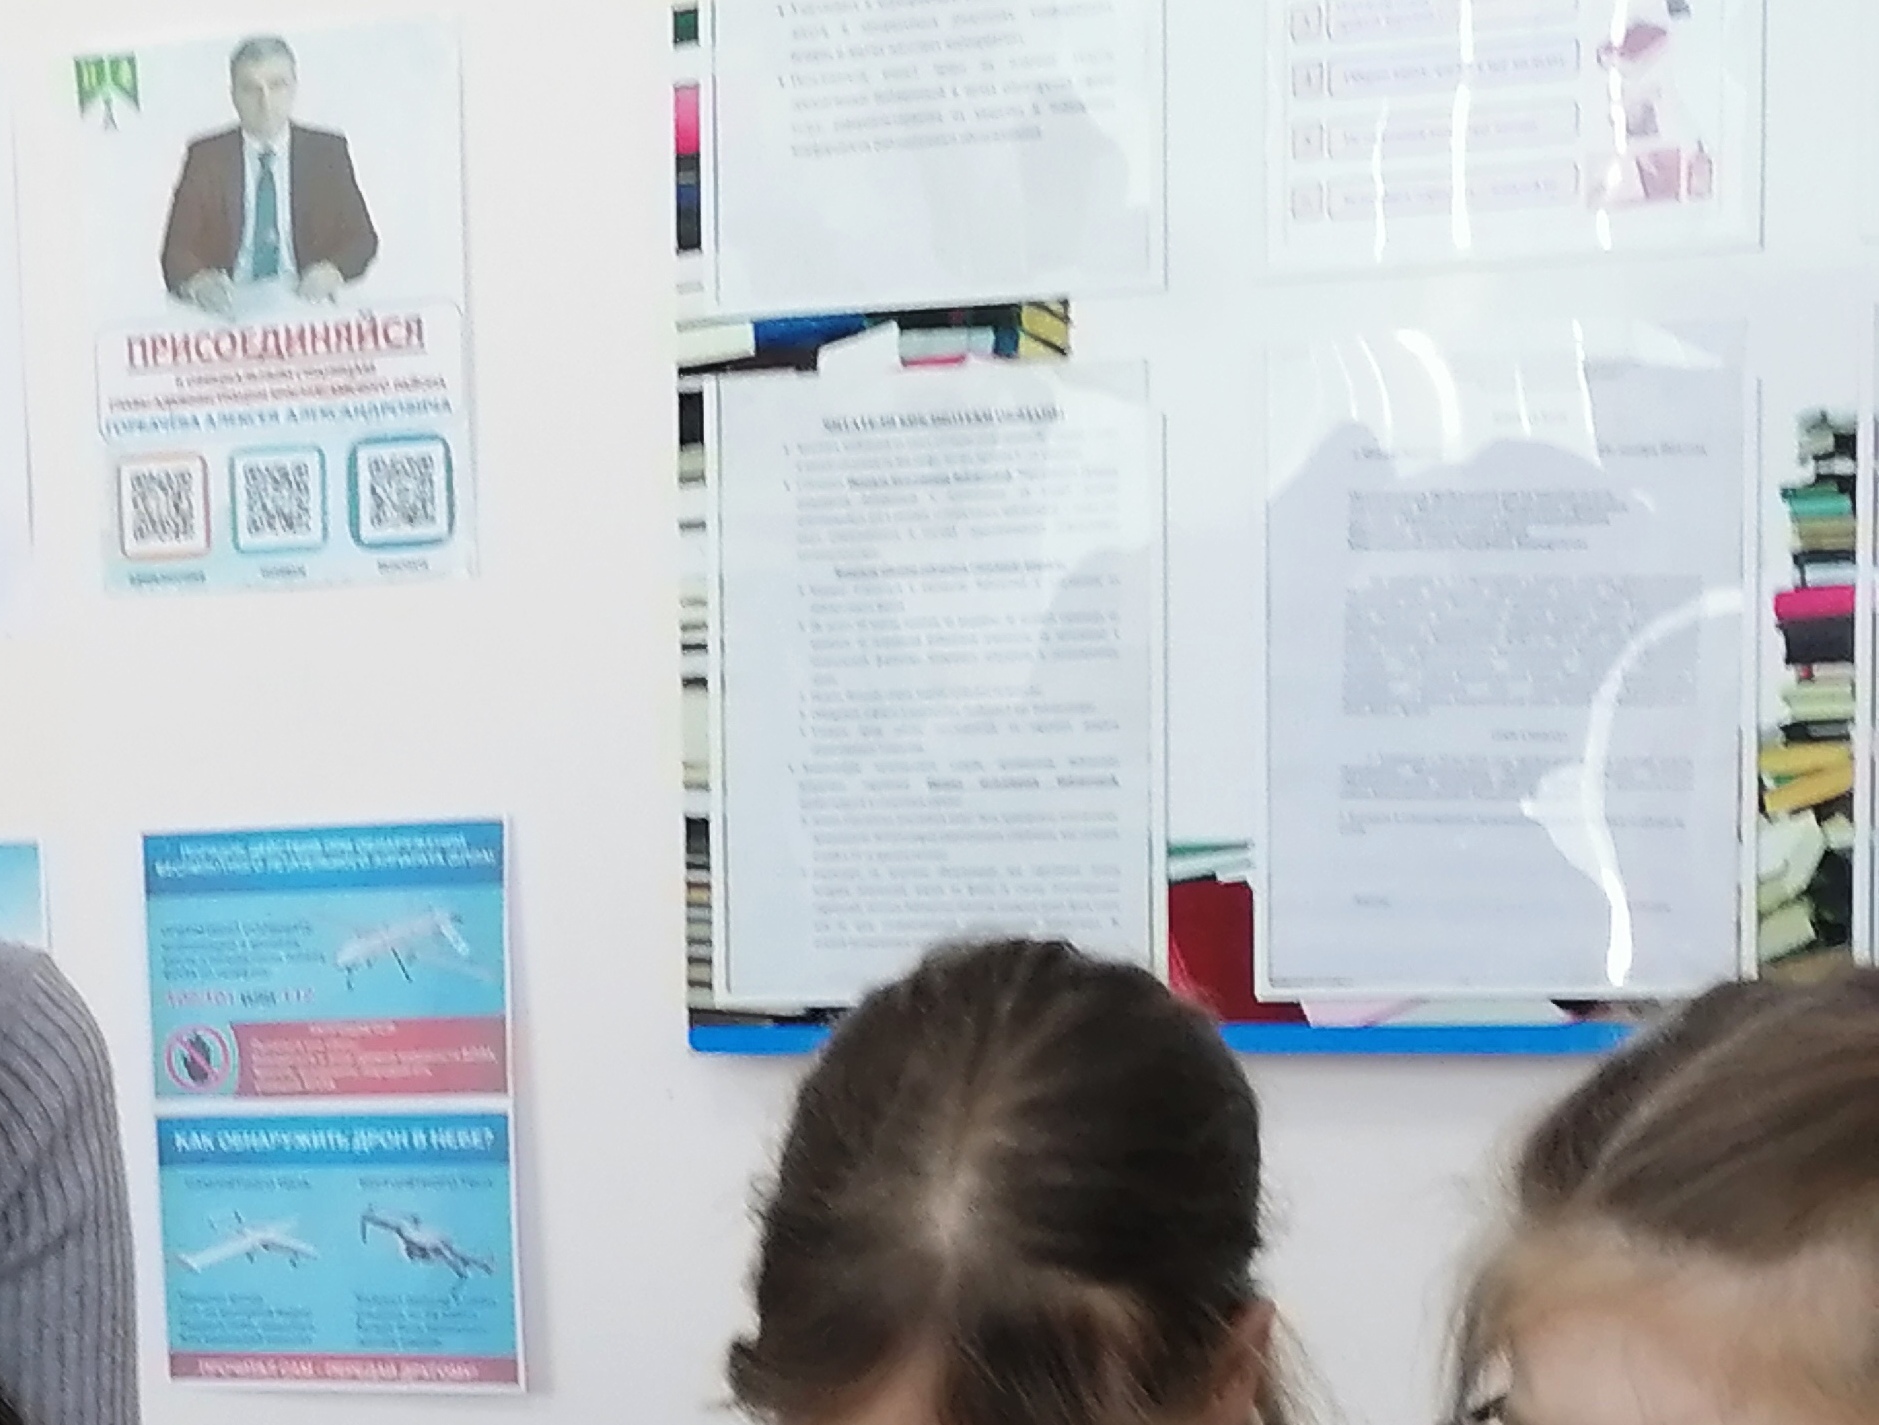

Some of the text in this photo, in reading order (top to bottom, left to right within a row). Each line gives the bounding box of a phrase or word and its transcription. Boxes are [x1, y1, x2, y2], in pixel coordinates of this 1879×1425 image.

[126, 310, 425, 368] ПРИСОЕДИНЯЙСЯ
[174, 1130, 214, 1153] КАК
[217, 1129, 350, 1153] ОБНАРУЖИТЬ
[351, 1128, 409, 1155] ДРОН
[430, 1127, 496, 1152] НЕБЕ?
